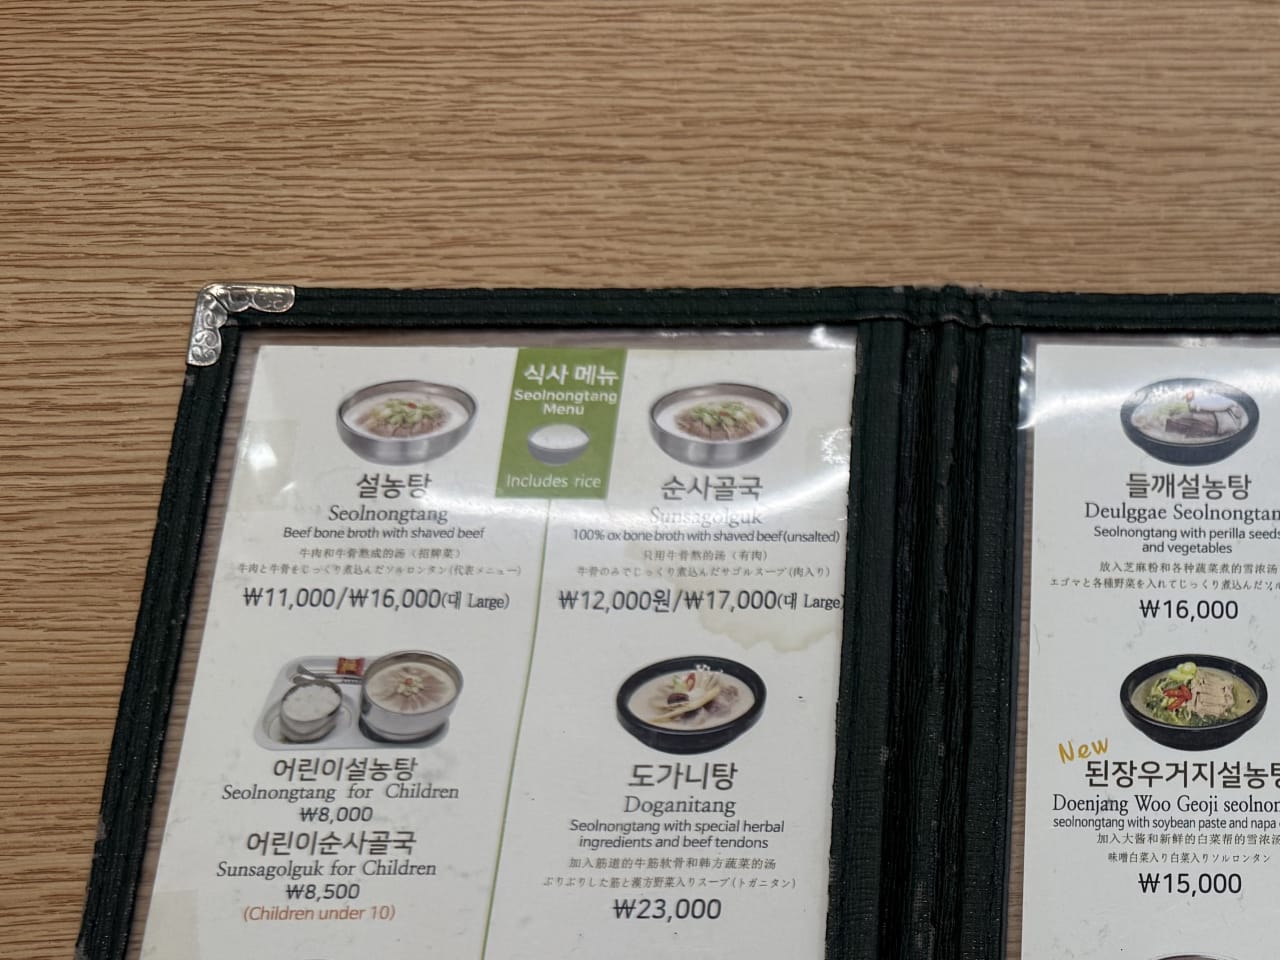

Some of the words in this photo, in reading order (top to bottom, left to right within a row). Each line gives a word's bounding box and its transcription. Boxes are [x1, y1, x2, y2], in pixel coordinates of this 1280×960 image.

[523, 363, 569, 386] 식사
[573, 364, 619, 386] 메뉴
[513, 388, 619, 404] Seolnongtang
[542, 401, 585, 416] Menu
[356, 472, 433, 500] 설농탕
[506, 473, 569, 488] Includes
[573, 473, 602, 489] rice
[660, 475, 764, 502] 순사골국
[1125, 472, 1252, 501] 들깨설농탕
[327, 503, 449, 526] Seolnongtang
[1084, 501, 1167, 524] Deulggae
[467, 592, 511, 611] Large)
[1057, 737, 1110, 764] New
[273, 757, 418, 785] 어린이설농탕
[627, 762, 739, 791] 도가니탕
[221, 783, 337, 804] Seolnongtang
[346, 782, 374, 799] for
[384, 782, 459, 799] Children
[623, 795, 737, 818] Doganitang
[1052, 793, 1129, 820] Doenjang
[1133, 794, 1172, 813] Woo
[1176, 794, 1219, 817] Geoji
[1052, 816, 1125, 831] seolnongtang
[1126, 815, 1150, 829] with
[1151, 815, 1196, 831] soybean
[1198, 818, 1227, 831] paste
[1228, 816, 1249, 829] and
[1250, 818, 1277, 831] napa
[246, 830, 417, 857] 어린이순사골국
[578, 835, 653, 851] ingredients
[654, 834, 681, 849] and
[682, 834, 713, 849] beef
[714, 834, 769, 850] tendons
[216, 859, 325, 881] Sunsagolguk
[328, 858, 357, 877] for
[361, 858, 437, 876] Children
[243, 904, 315, 923] (Children
[317, 904, 367, 921] under
[370, 904, 396, 921] 10)
